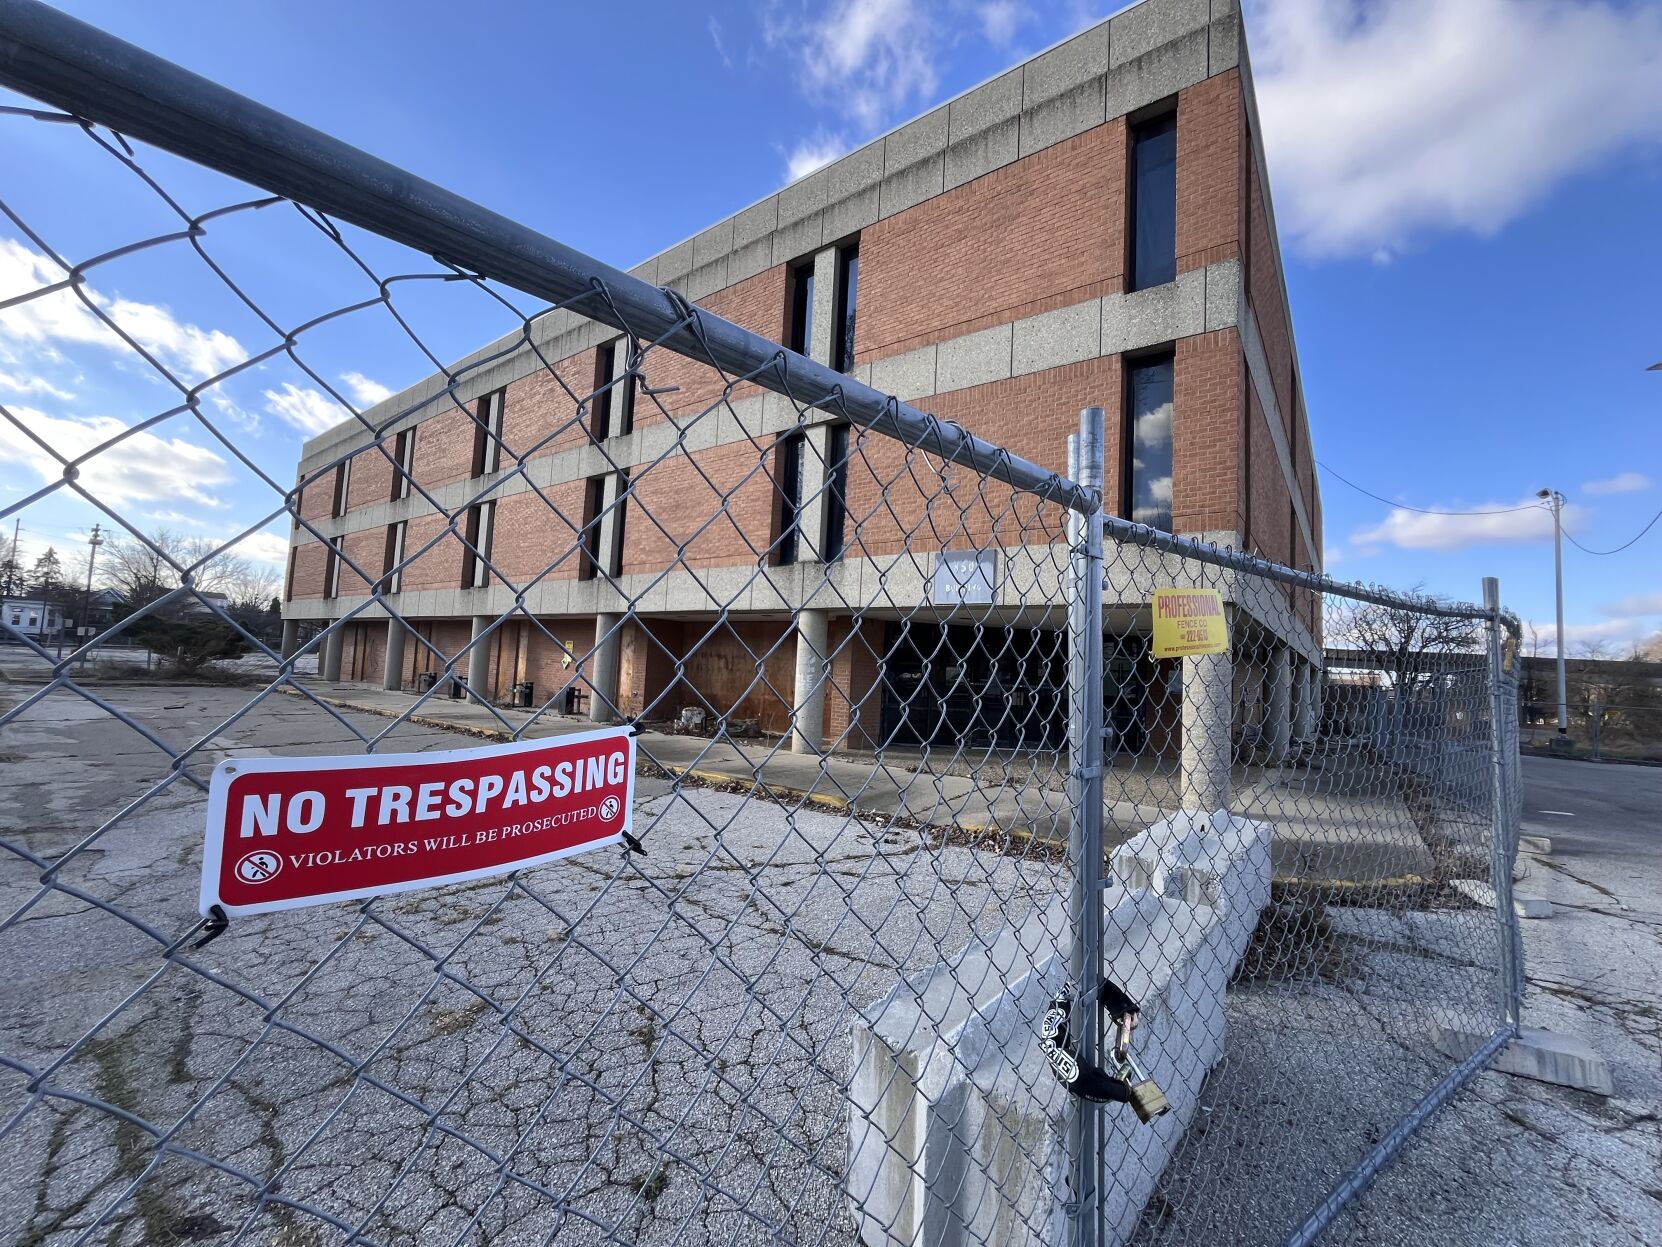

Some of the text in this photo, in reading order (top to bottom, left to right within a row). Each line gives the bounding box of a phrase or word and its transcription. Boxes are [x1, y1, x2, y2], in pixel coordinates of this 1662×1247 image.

[1158, 595, 1221, 618] PROFESSIONAL
[1177, 620, 1198, 629] FENCE
[240, 751, 625, 838] NO TRESPASSING
[289, 807, 597, 869] VIOLATORS WILL BE PROSECUTED
